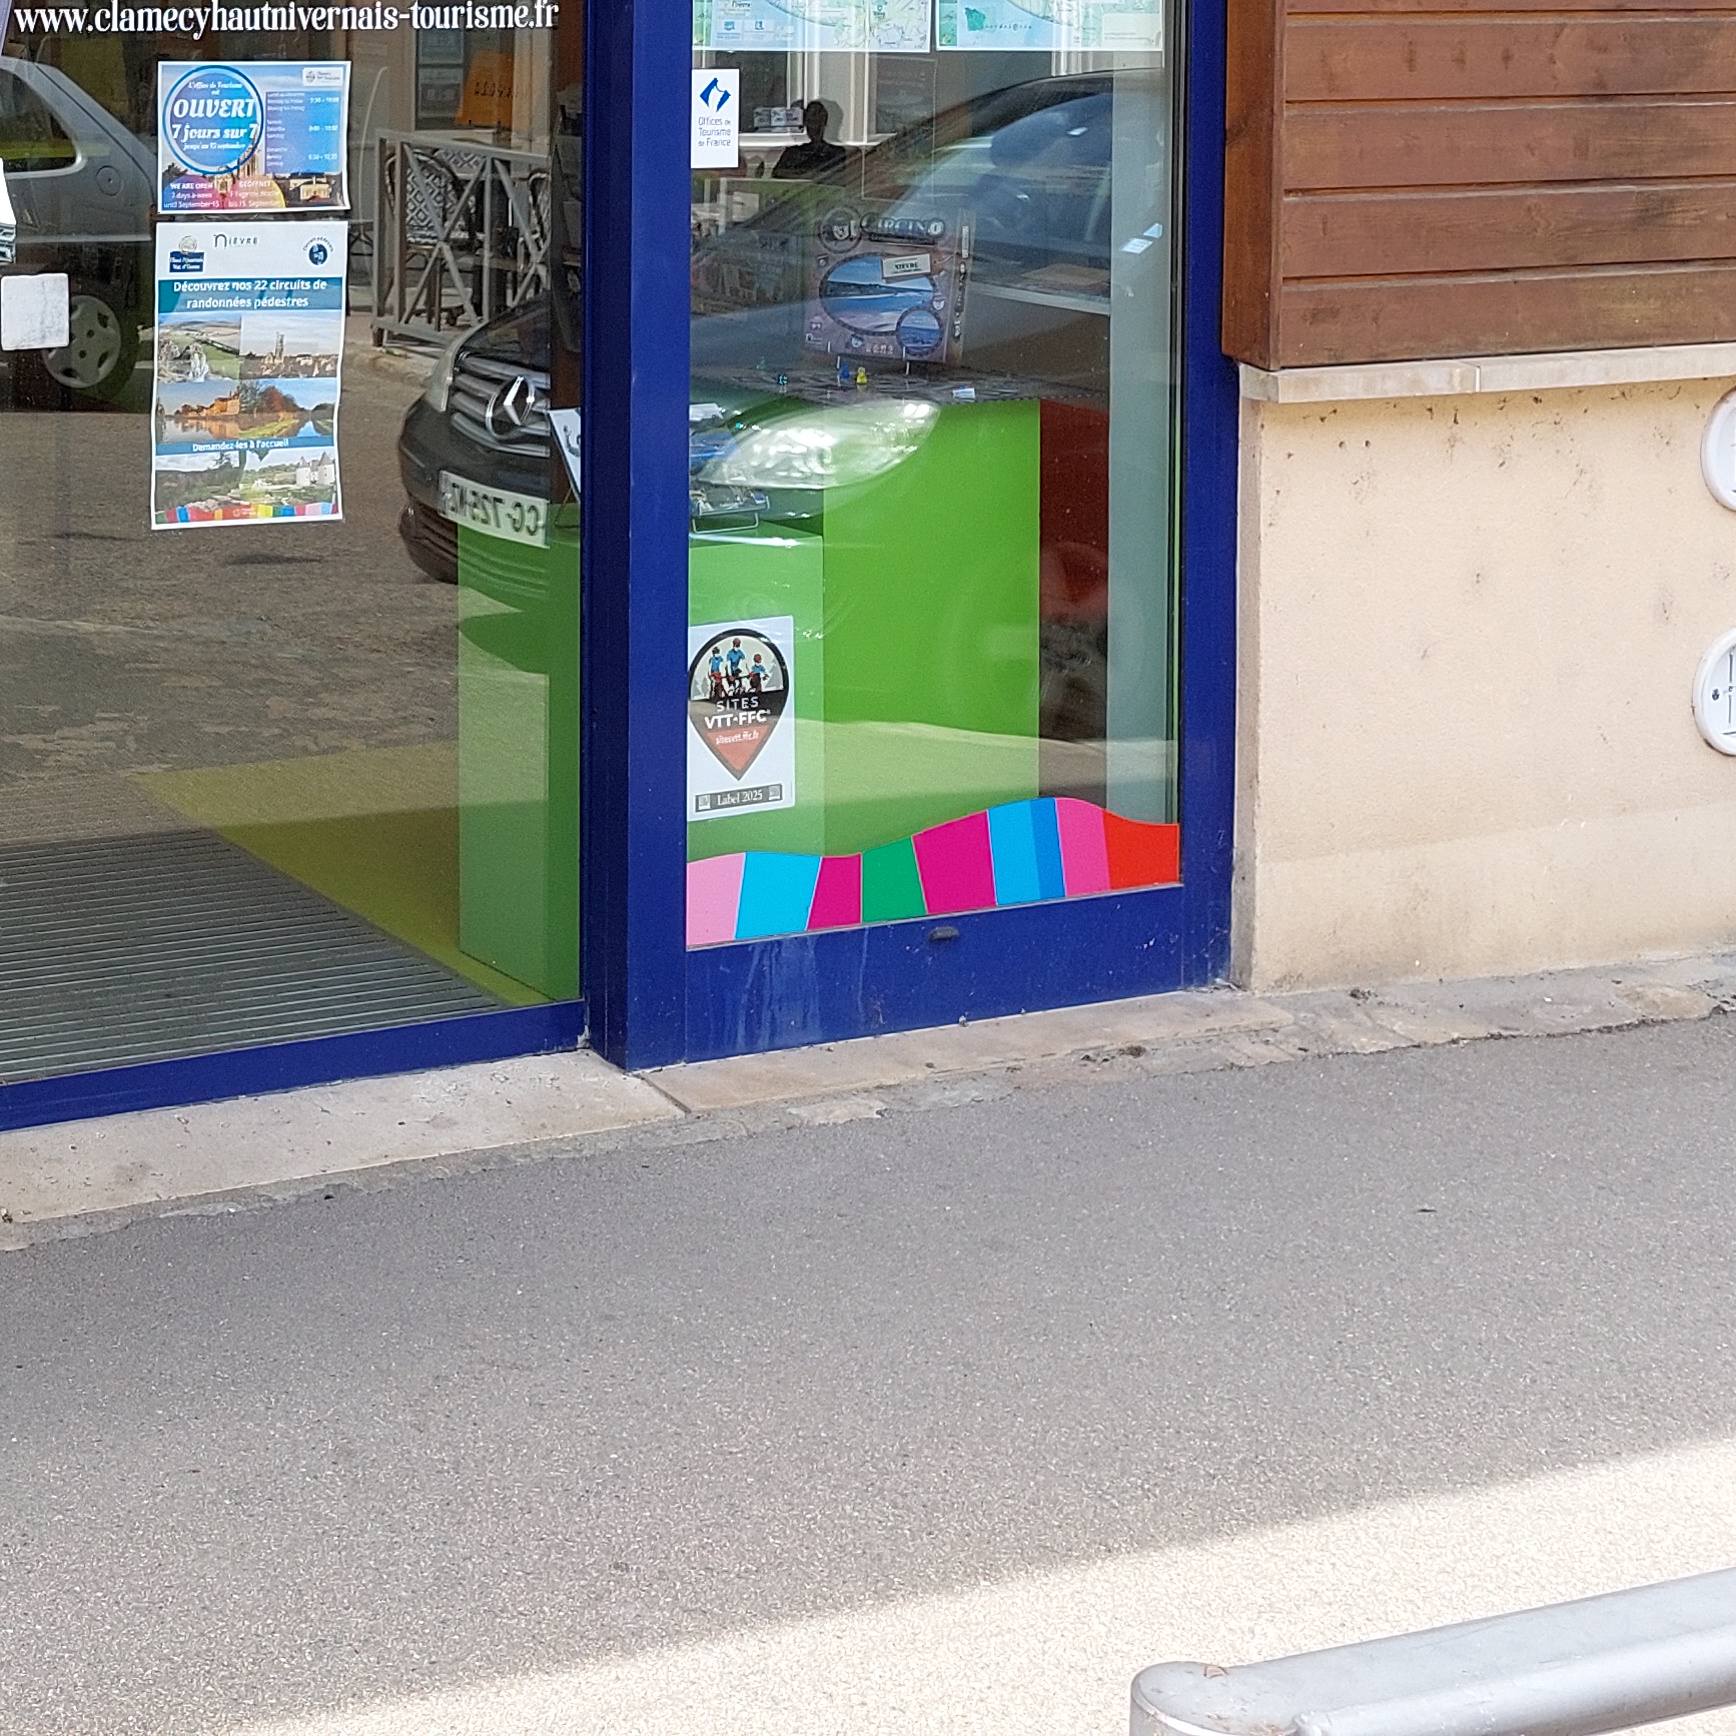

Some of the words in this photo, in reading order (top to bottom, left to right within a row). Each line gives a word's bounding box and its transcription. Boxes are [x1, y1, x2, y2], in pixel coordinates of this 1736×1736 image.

[173, 98, 256, 118] OUVERT
[698, 116, 722, 126] Offices
[172, 124, 179, 139] 7
[181, 123, 220, 142] jours
[223, 128, 247, 138] sur
[249, 124, 257, 138] 7
[698, 128, 731, 137] Tourisme
[707, 138, 730, 146] France
[174, 281, 230, 292] Découvrez
[232, 282, 251, 291] nos
[254, 281, 267, 290] 22
[270, 280, 310, 290] circuits
[314, 280, 327, 290] de
[187, 298, 251, 309] randonnées
[254, 297, 308, 309] pédestres
[716, 697, 758, 712] SITES
[717, 792, 739, 806] Label
[743, 789, 763, 802] 2025
